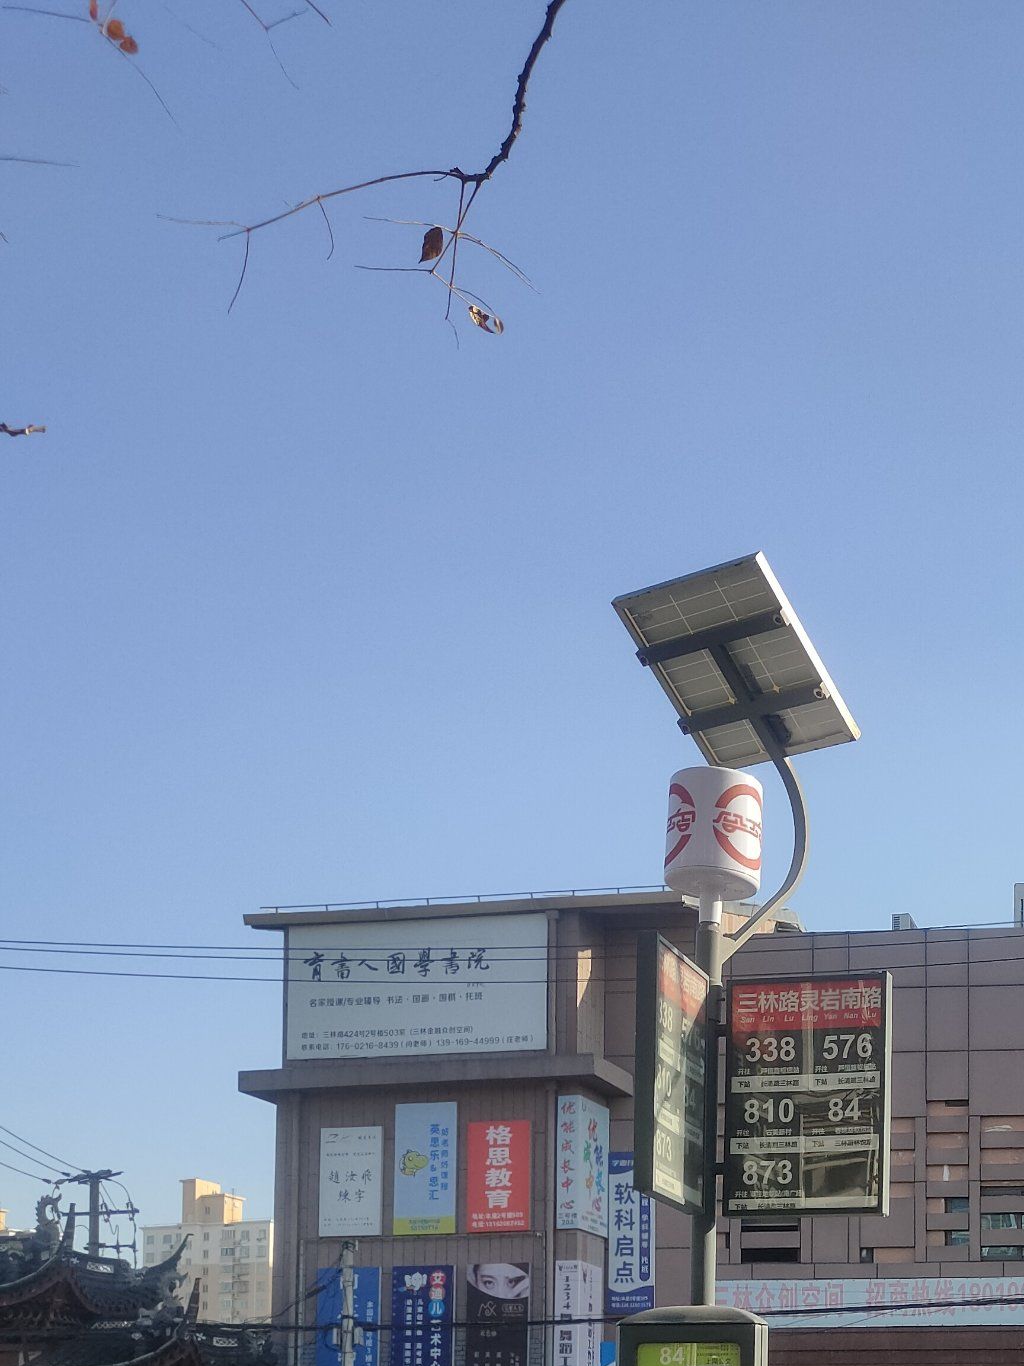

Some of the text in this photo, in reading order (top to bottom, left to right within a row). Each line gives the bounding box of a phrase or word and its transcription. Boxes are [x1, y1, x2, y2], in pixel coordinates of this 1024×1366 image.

[737, 987, 882, 1014] 三林路灵岩南路
[762, 1015, 775, 1023] Lin
[784, 1014, 794, 1022] Lu
[824, 1012, 838, 1020] Yan
[844, 1011, 858, 1019] Nan
[745, 1033, 873, 1062] 338 576
[814, 1078, 828, 1086] 下站
[744, 1098, 862, 1124] 810 84
[485, 1125, 513, 1209] 格思教育
[742, 1159, 793, 1185] 873
[614, 1182, 636, 1284] 软科启点
[660, 1346, 685, 1365] 84
